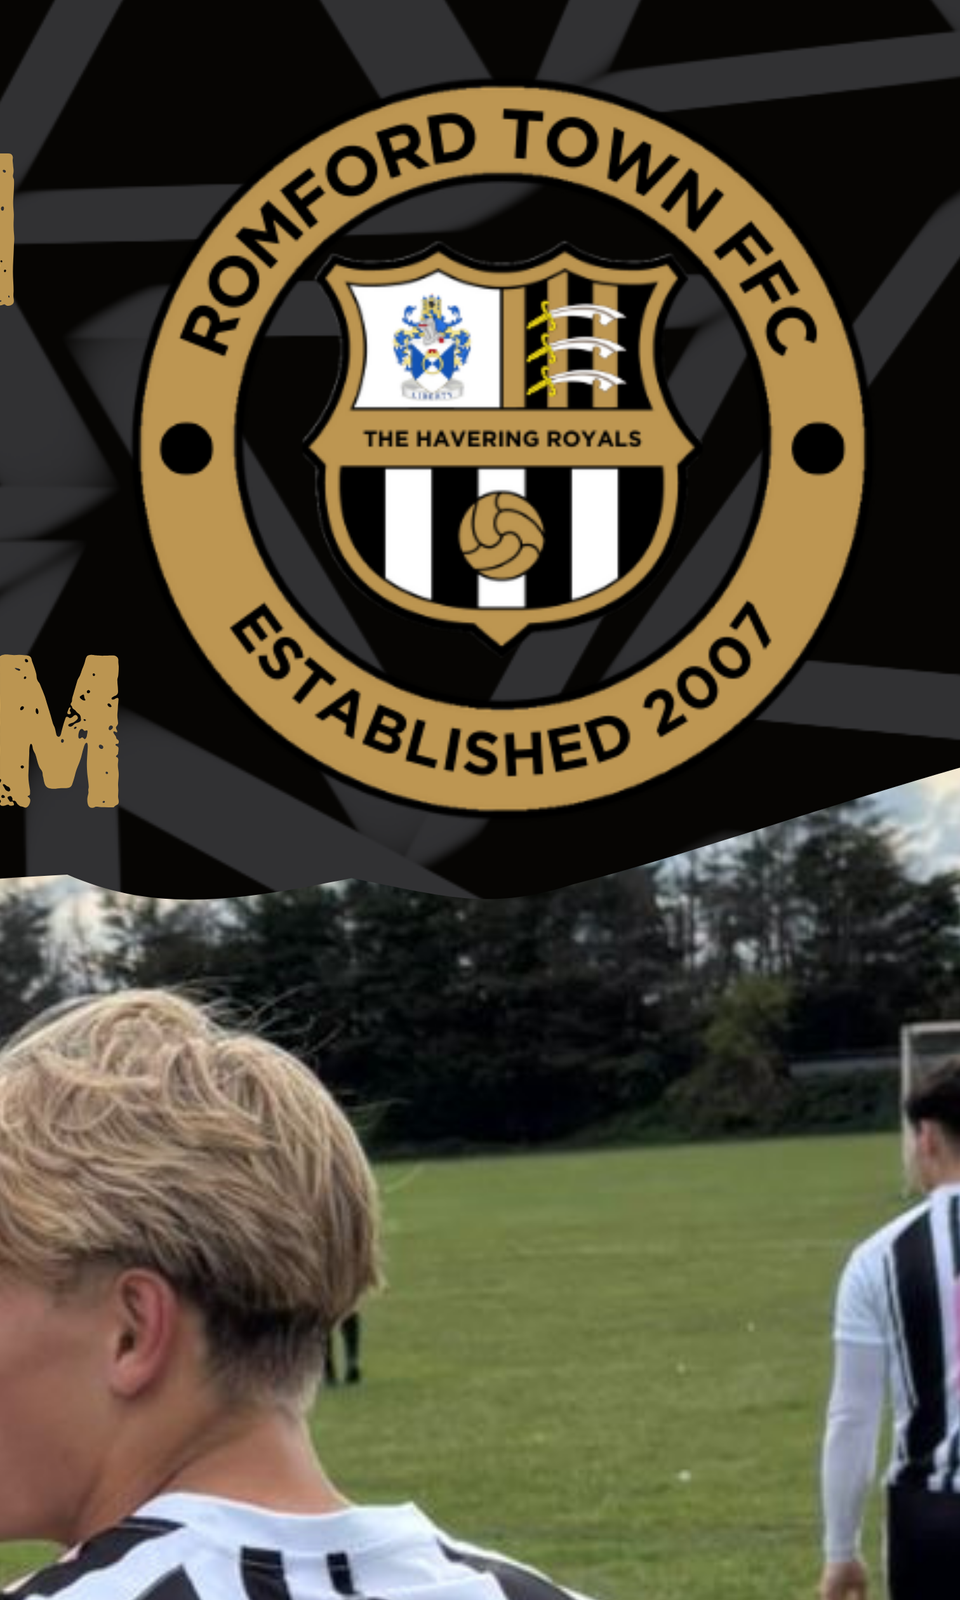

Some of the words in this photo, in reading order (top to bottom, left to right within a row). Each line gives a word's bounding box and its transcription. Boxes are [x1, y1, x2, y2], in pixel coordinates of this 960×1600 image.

[180, 112, 478, 356] ROMFORD
[502, 108, 724, 232] TOWN
[714, 221, 818, 357] FFC
[363, 430, 409, 448] THE
[416, 430, 540, 448] HAVERING
[547, 430, 642, 448] ROYALS
[230, 603, 631, 777] ESTABLISHED
[643, 601, 772, 738] 2007
